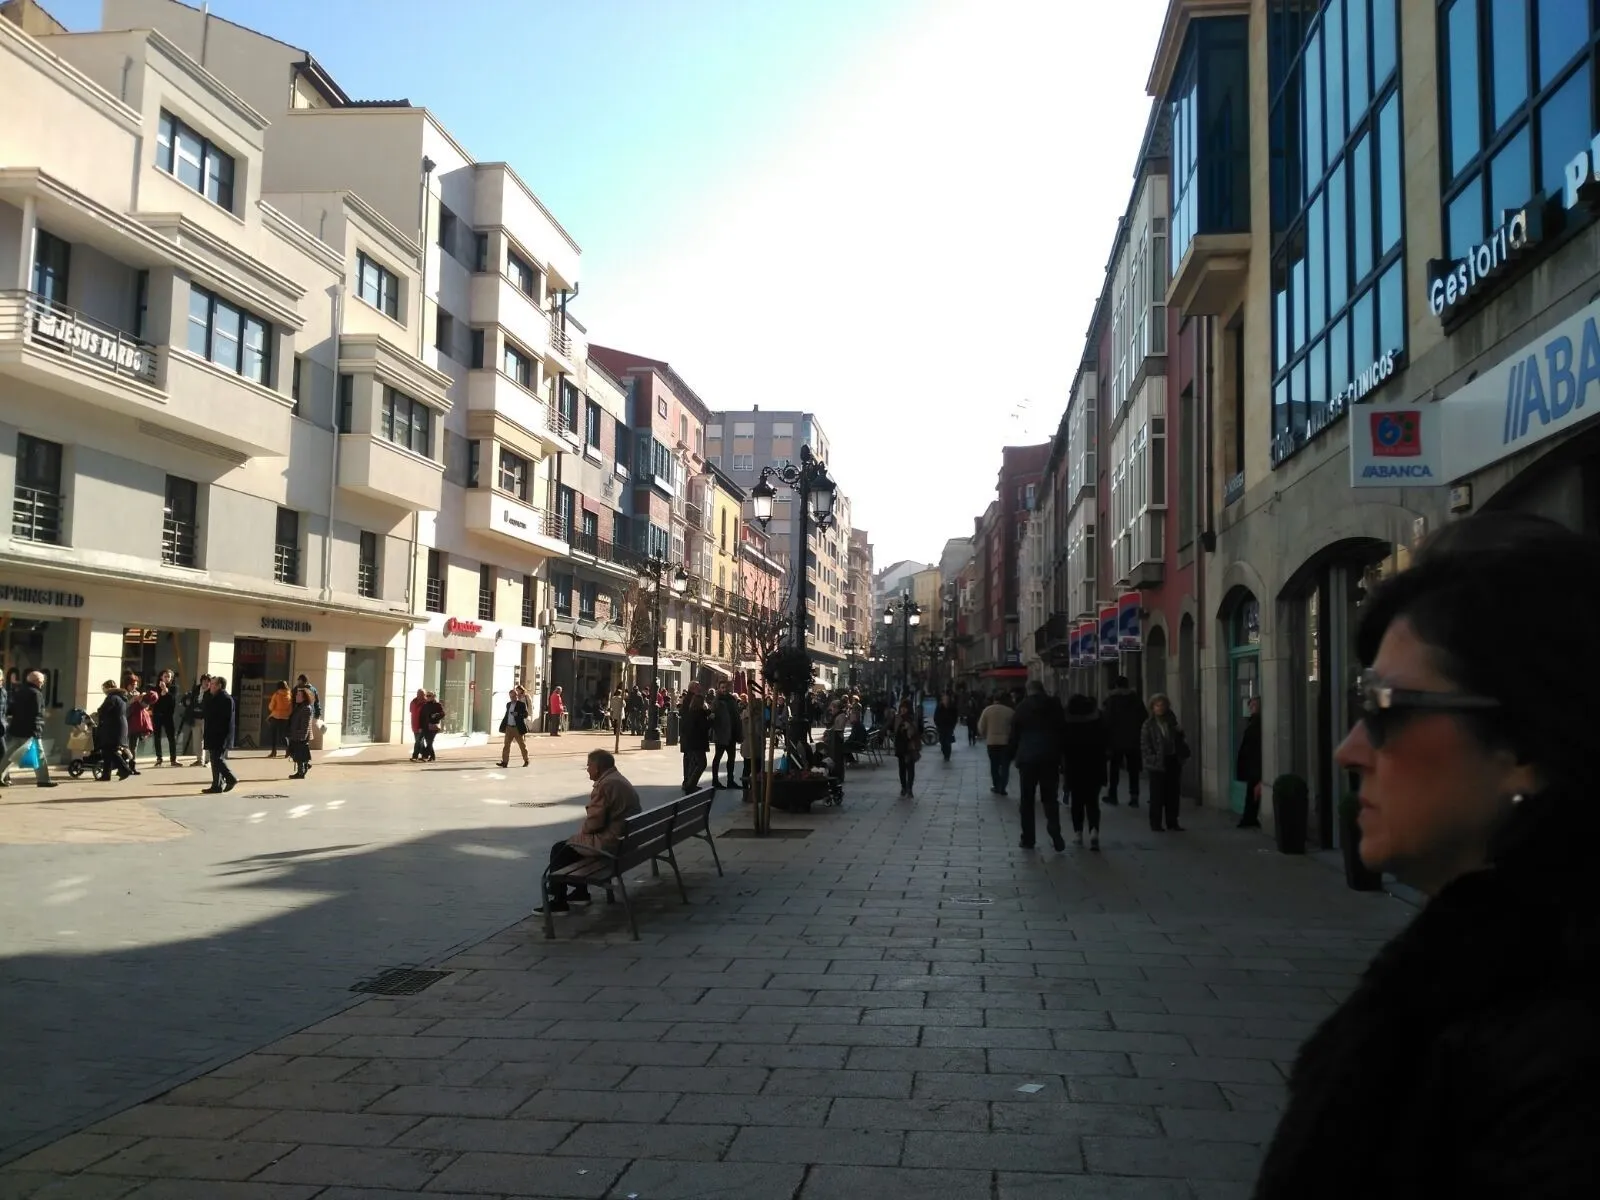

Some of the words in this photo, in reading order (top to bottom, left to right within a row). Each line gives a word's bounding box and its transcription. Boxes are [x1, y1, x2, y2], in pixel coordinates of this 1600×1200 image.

[1430, 208, 1527, 317] Gestoria
[55, 318, 99, 354] JESUS
[1348, 349, 1394, 402] CLINICOS
[1364, 464, 1433, 478] ABANCA
[260, 616, 311, 632] SPRINGFIELD
